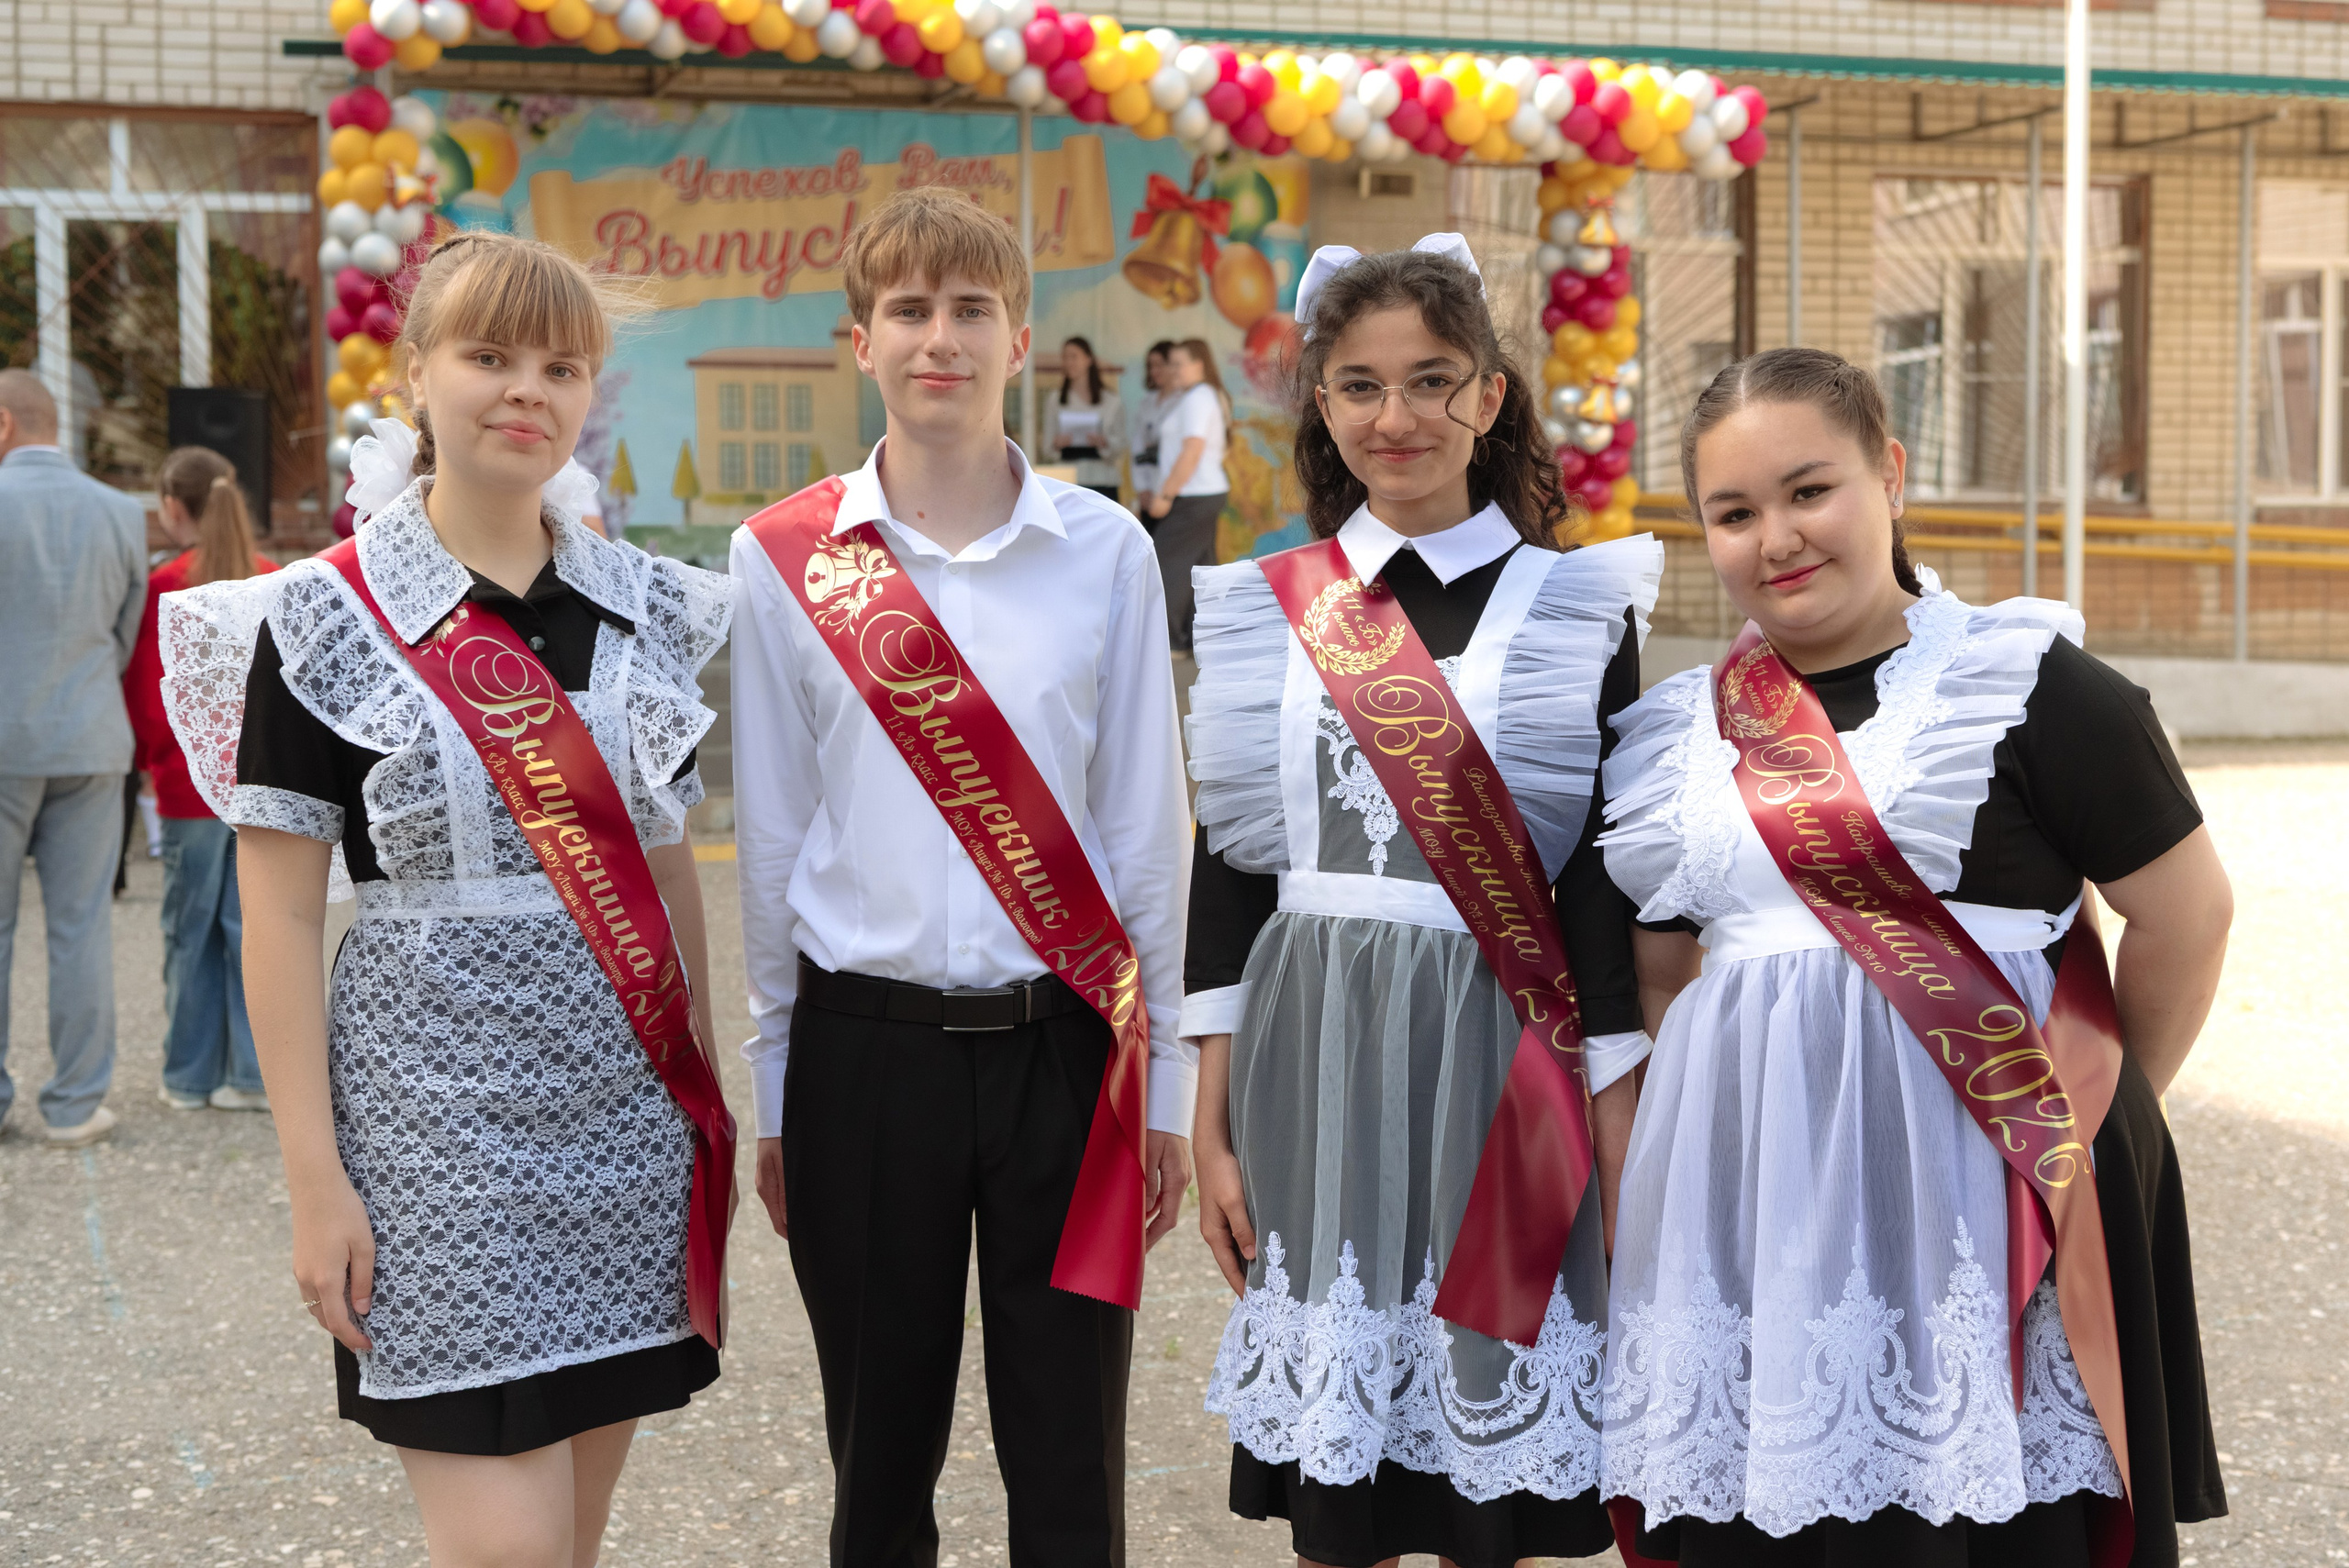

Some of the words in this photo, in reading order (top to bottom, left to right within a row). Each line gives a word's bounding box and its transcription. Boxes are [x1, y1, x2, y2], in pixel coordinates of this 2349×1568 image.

[661, 147, 869, 203] Успехов
[1331, 611, 1360, 647] класс
[1343, 596, 1364, 609] 11
[1744, 682, 1765, 715] класс
[1753, 662, 1769, 677] 11
[476, 734, 496, 751] 11
[486, 752, 508, 774] «А»
[500, 776, 526, 810] класс
[885, 714, 904, 730] 11
[896, 731, 917, 751] «А»
[910, 752, 939, 784] класс
[449, 635, 657, 979] Выпускница
[859, 609, 1069, 929] Выпускник
[1044, 916, 1140, 1026] 2026
[950, 810, 979, 837] МОУ
[1353, 674, 1543, 962] Выпускница
[1463, 767, 1526, 864] Рамазанова
[968, 839, 996, 873] «Лицей
[988, 869, 1005, 884] №
[1416, 826, 1447, 858] МОУ
[1438, 862, 1467, 899] Лицей
[1841, 810, 1913, 900] Кадрашева
[537, 839, 564, 868] МОУ
[555, 871, 582, 907] «Лицей
[574, 906, 591, 920] №
[584, 920, 598, 938] 10»
[600, 945, 629, 987] Волгоград
[996, 883, 1013, 900] 10»
[1012, 906, 1043, 945] Волгоград
[1795, 874, 1831, 906] МОУ
[1823, 911, 1858, 942] Лицей
[1745, 733, 1956, 1000] Выпускница
[1926, 1004, 2091, 1188] 2026
